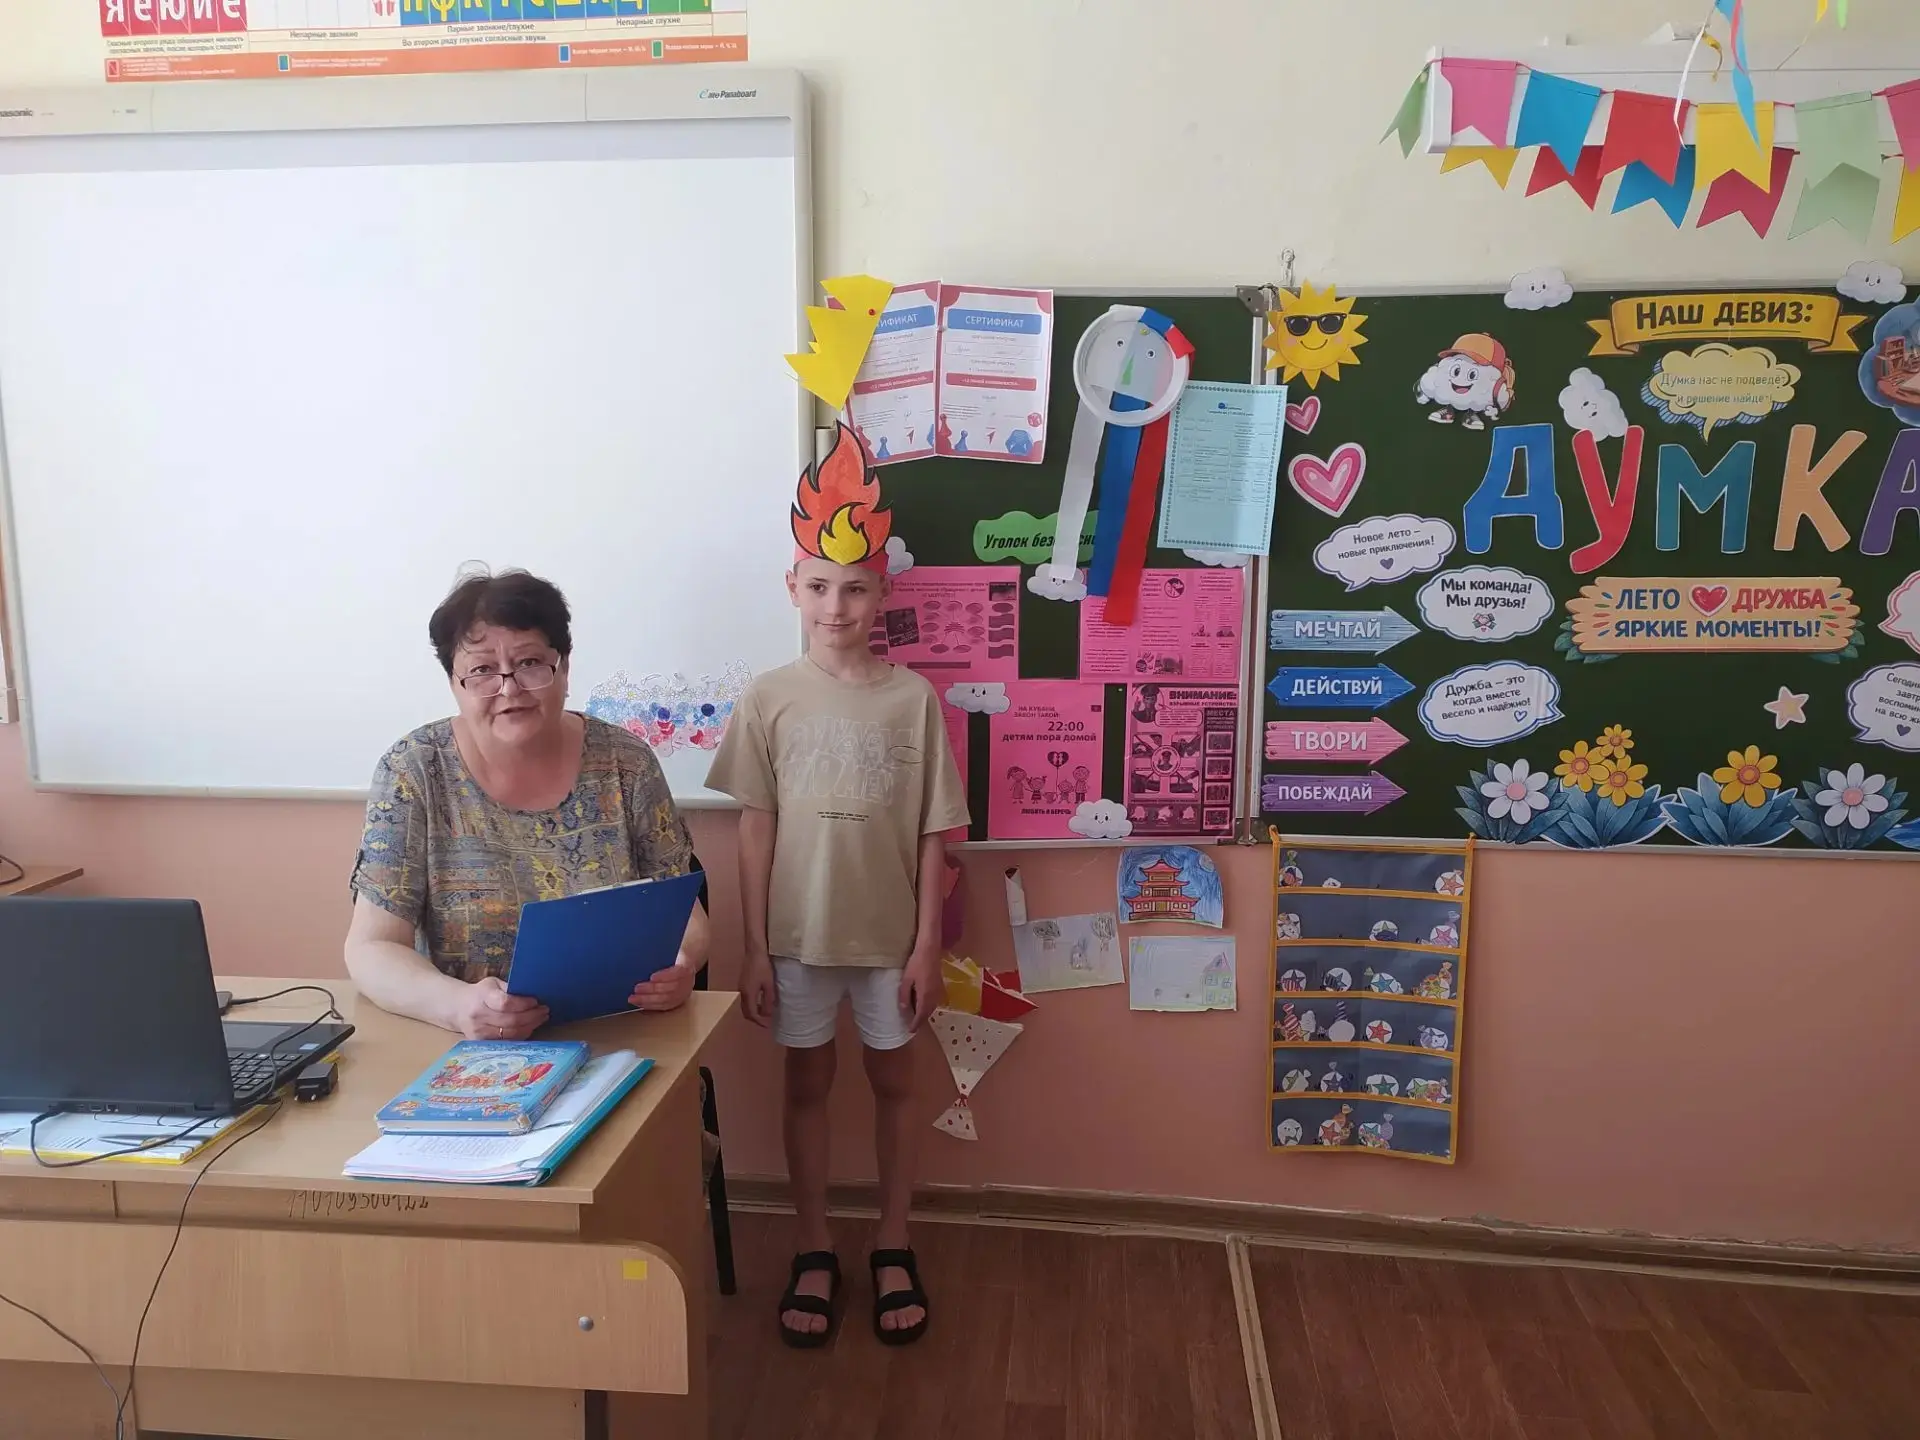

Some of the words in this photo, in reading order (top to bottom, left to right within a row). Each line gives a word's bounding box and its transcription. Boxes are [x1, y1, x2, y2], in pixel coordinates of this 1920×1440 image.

[965, 315, 1024, 329] СЕРТИФИКАТ
[1713, 301, 1813, 326] ДЕВИЗ:
[1661, 373, 1696, 387] Думка
[1699, 375, 1718, 385] нас
[1720, 375, 1733, 385] не
[1687, 395, 1730, 405] решение
[1463, 423, 1920, 575] ДУМКА
[984, 533, 1029, 549] Уголок
[1353, 533, 1385, 545] Новое
[1387, 528, 1411, 540] лето
[1338, 549, 1367, 560] новые
[1369, 535, 1435, 556] приключения!
[1440, 578, 1466, 592] Мы
[1469, 580, 1532, 594] команда!
[1446, 594, 1471, 608] Мы
[1474, 596, 1526, 609] друзья!
[1615, 588, 1681, 610] ЛЕТО
[1731, 588, 1828, 613] ДРУЖБА
[1295, 618, 1381, 638] МЕЧТАЙ
[1614, 620, 1689, 638] ЯРКИЕ
[1695, 620, 1821, 638] МОМЕНТЫ!
[1291, 676, 1383, 697] ДЕЙСТВУЙ
[1445, 680, 1493, 698] Дружба
[1505, 675, 1526, 685] это
[1452, 696, 1483, 707] когда
[1485, 689, 1521, 701] вместе
[1879, 696, 1920, 713] воспомин
[1896, 689, 1920, 703] завтр
[1441, 709, 1476, 720] весело
[1487, 697, 1531, 712] надёжно!
[1875, 707, 1886, 715] на
[1889, 711, 1908, 720] всю
[1909, 716, 1920, 724] жи
[1047, 721, 1085, 731] 22:00
[1002, 733, 1034, 742] детям
[1036, 734, 1060, 742] пора
[1063, 732, 1097, 742] домой
[1291, 731, 1368, 751] ТВОРИ
[1278, 783, 1373, 802] ПОБЕЖДАЙ
